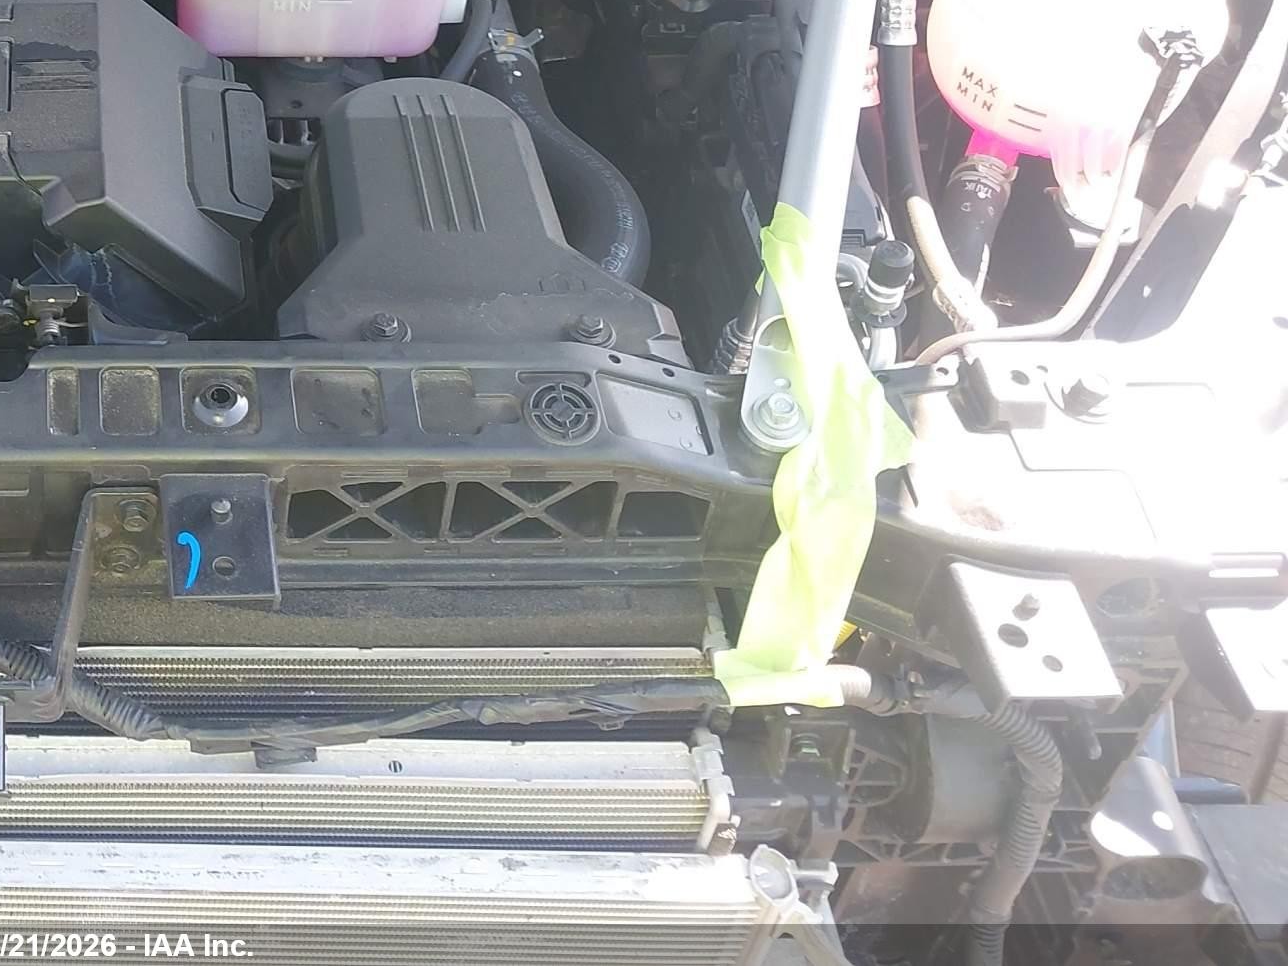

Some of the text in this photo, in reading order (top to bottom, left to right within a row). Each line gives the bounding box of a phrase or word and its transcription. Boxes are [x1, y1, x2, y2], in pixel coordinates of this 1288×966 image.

[273, 0, 312, 12] MIN
[957, 81, 993, 112] MIN
[962, 66, 997, 98] MAX
